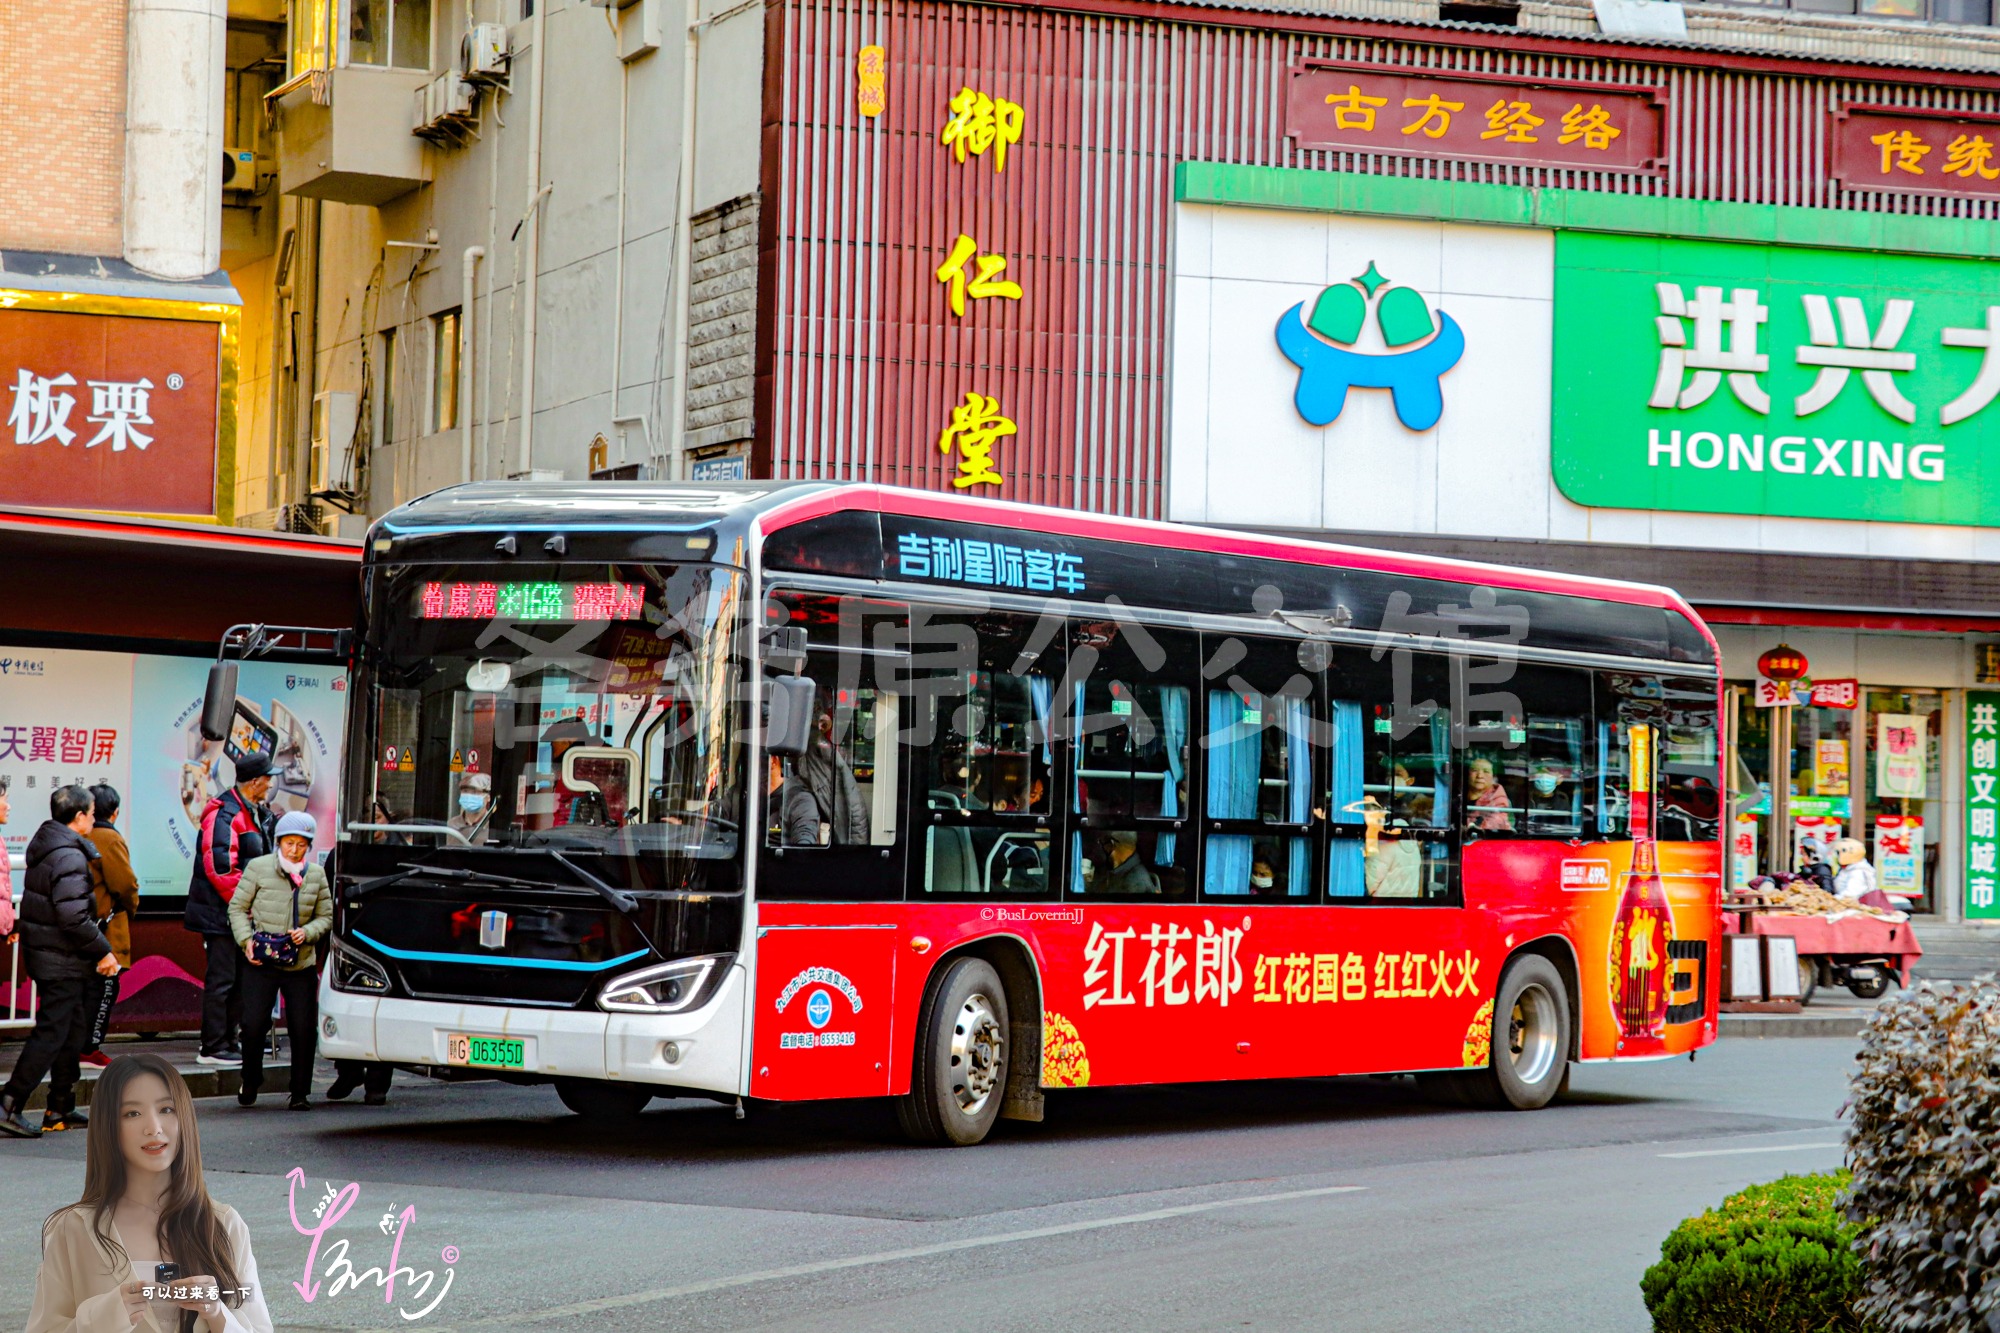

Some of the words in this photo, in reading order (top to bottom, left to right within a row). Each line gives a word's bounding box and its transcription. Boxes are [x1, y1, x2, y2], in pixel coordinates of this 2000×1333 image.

[1325, 85, 1621, 151] 古方经络
[1871, 130, 2000, 181] 传统
[937, 86, 1025, 489] 御仁堂
[8, 367, 154, 452] 板栗
[1648, 428, 1946, 481] HONGXING
[898, 532, 1086, 594] 吉利星际客车
[0, 726, 117, 765] 天翼智屏
[1969, 703, 1998, 909] 共创文明城市
[775, 966, 863, 1013] 九江市公共交通集团公司
[1083, 919, 1244, 1010] 红花郎
[1253, 952, 1367, 1004] 红花国色
[1374, 949, 1480, 999] 红红火火
